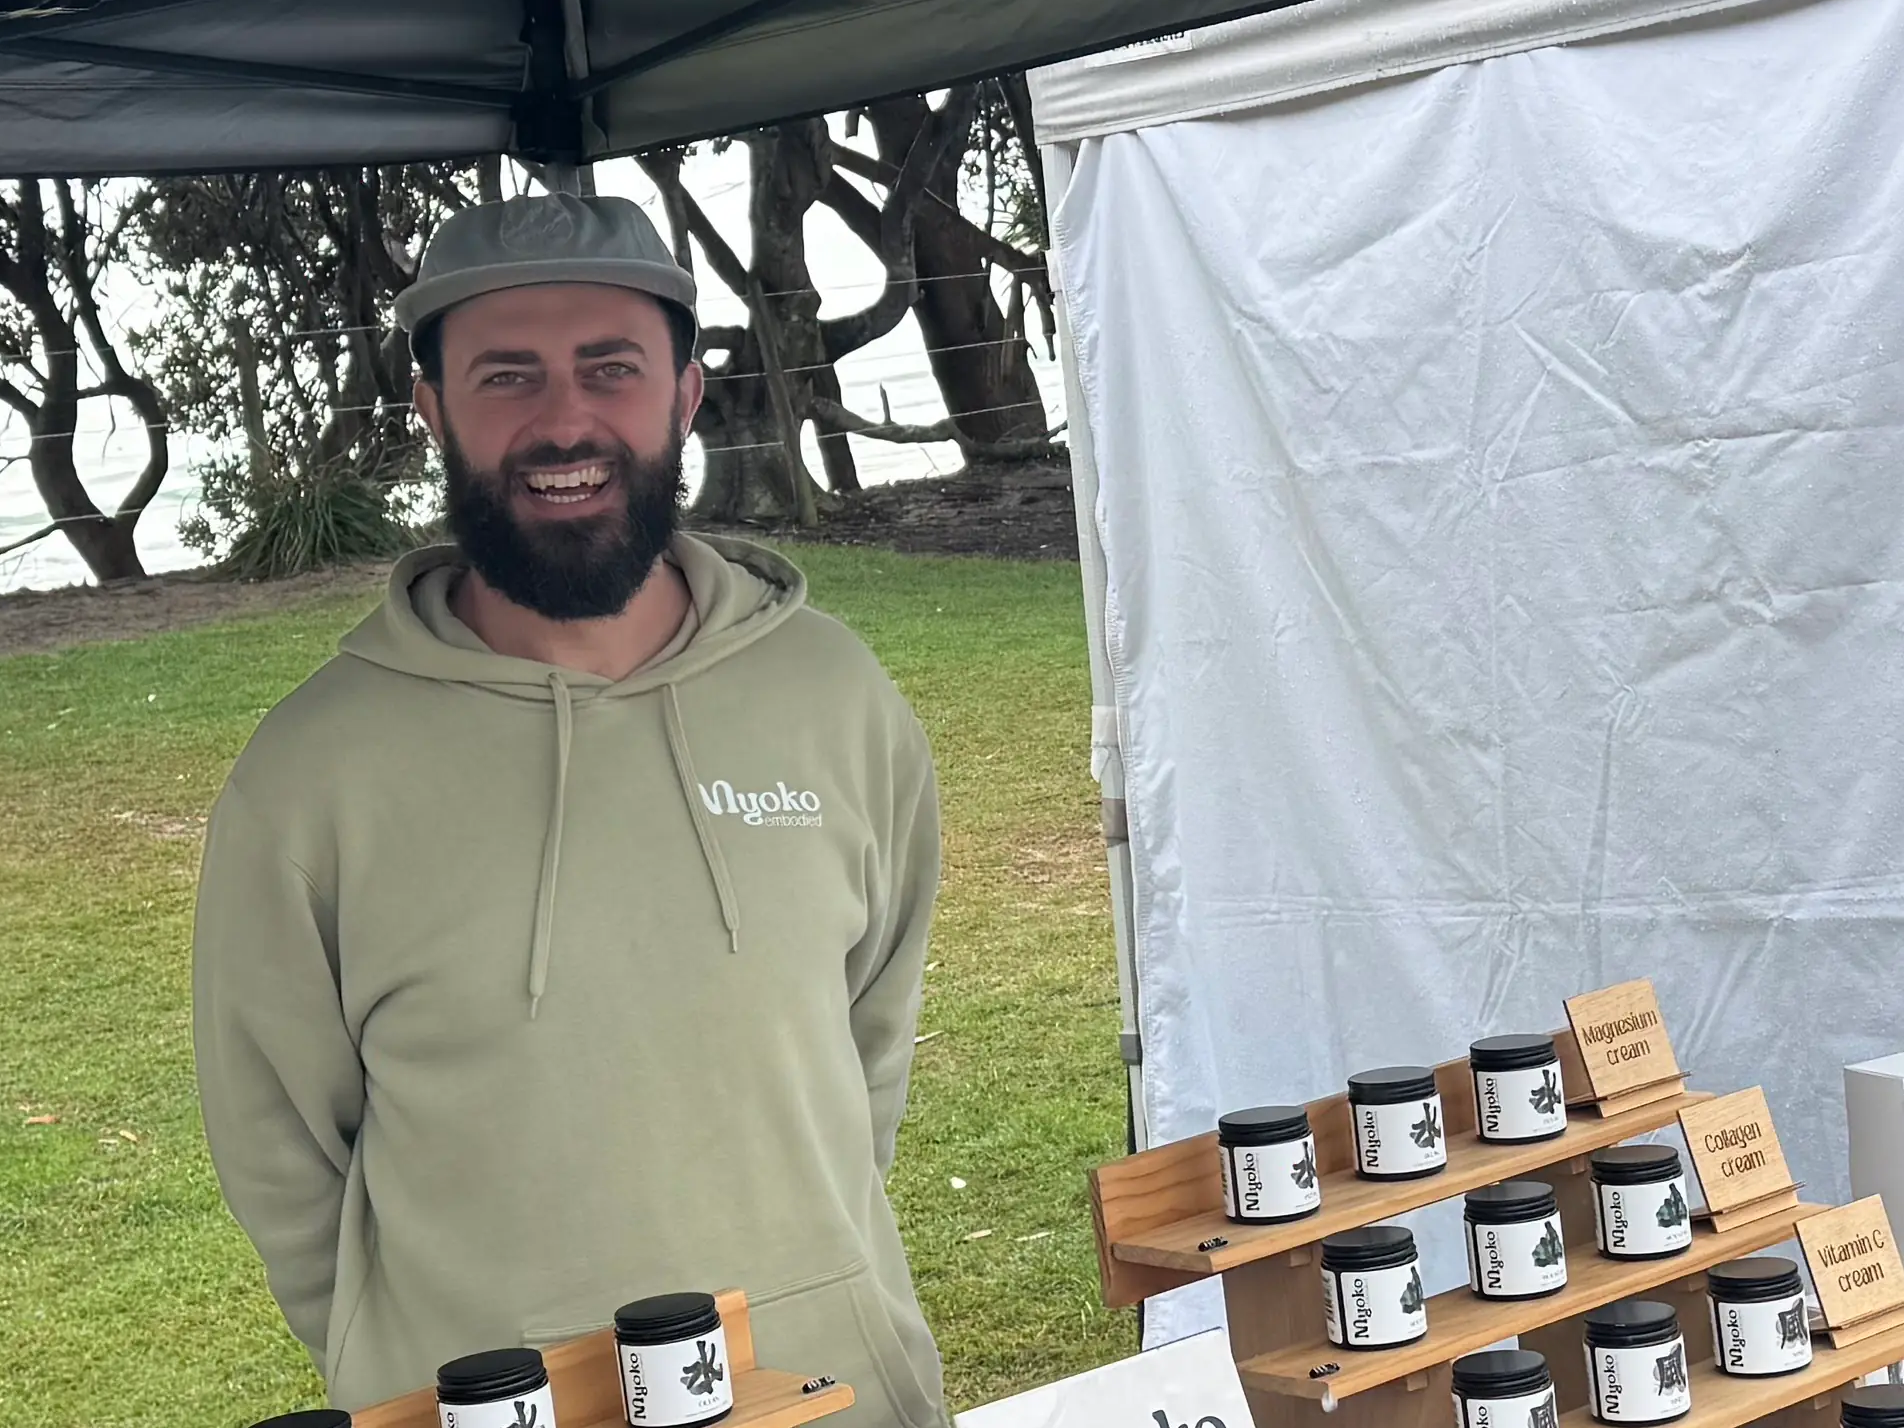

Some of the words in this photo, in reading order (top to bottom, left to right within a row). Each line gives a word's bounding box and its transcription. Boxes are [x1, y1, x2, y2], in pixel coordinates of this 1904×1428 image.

[698, 780, 821, 825] Myoko
[1581, 1010, 1658, 1047] Magnesium
[1606, 1039, 1651, 1066] cream
[1484, 1077, 1502, 1132] Myoko
[1364, 1110, 1381, 1168] Myoko
[1705, 1120, 1761, 1153] Collagen
[1244, 1153, 1262, 1211] Myoko
[1721, 1151, 1766, 1179] cream
[1610, 1191, 1628, 1248] Myoko
[1485, 1231, 1504, 1289] Myoko
[1817, 1231, 1874, 1268] Vitamin
[1872, 1229, 1885, 1251] C
[1838, 1262, 1885, 1293] cream
[1352, 1278, 1372, 1338] Myoko
[1727, 1309, 1746, 1368] Myoko
[628, 1352, 647, 1419] Myoko
[1603, 1354, 1623, 1415] Myoko
